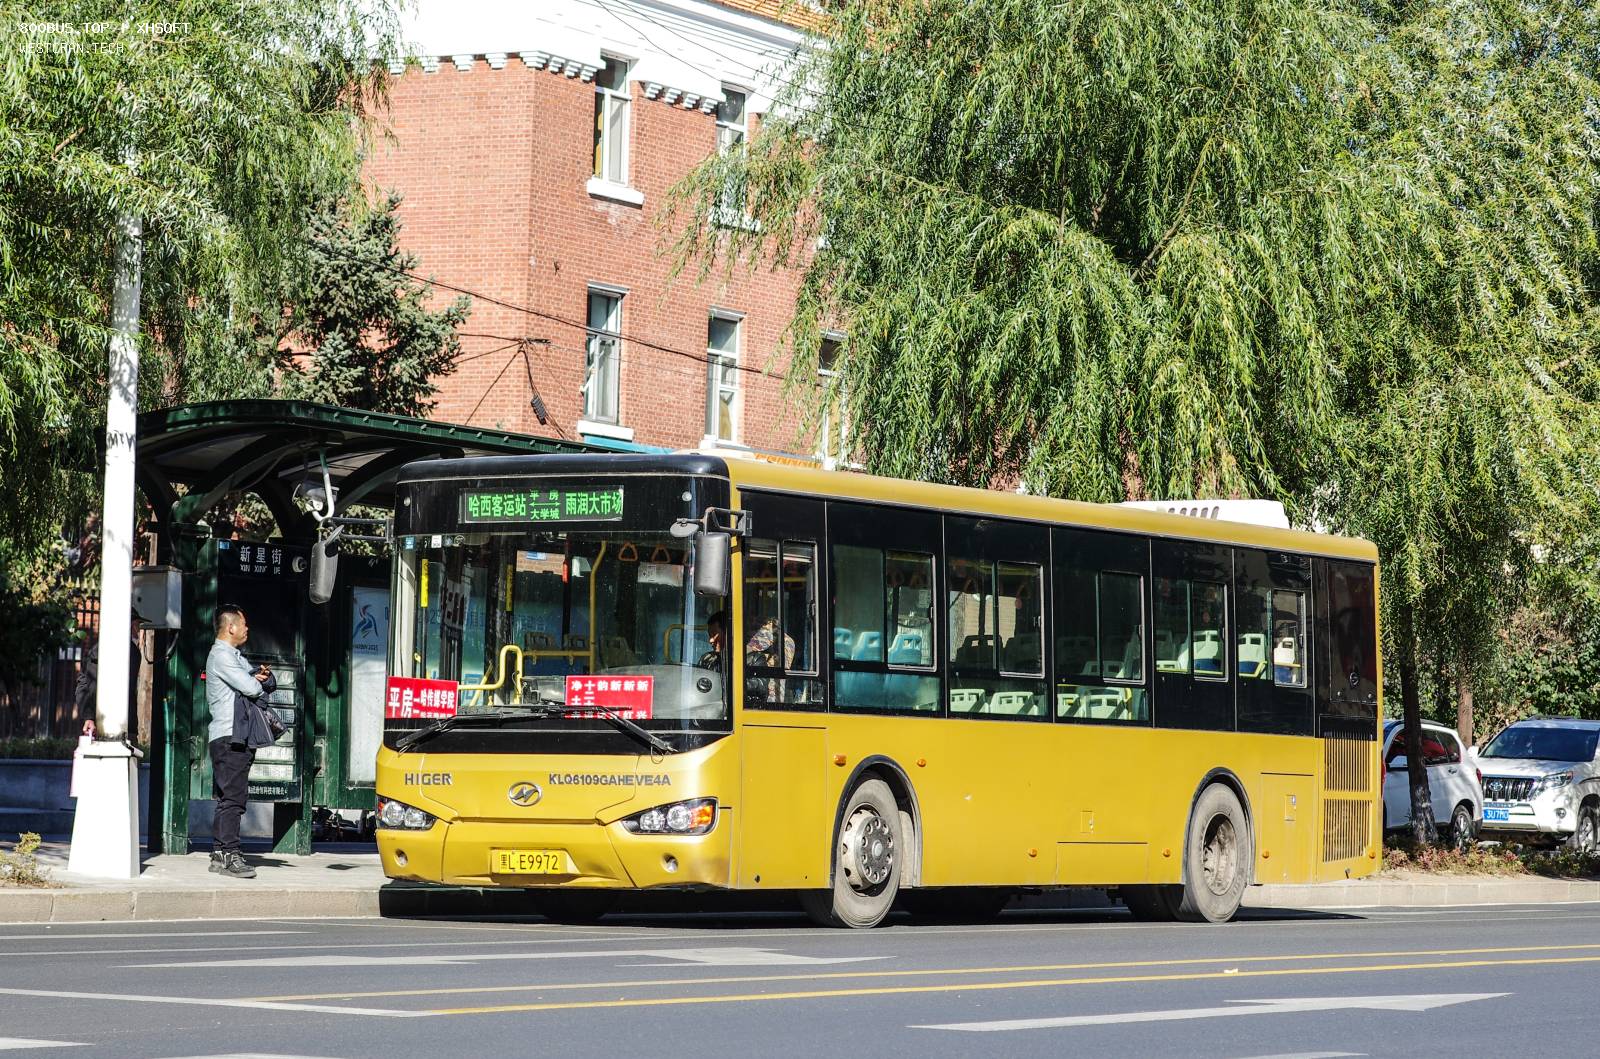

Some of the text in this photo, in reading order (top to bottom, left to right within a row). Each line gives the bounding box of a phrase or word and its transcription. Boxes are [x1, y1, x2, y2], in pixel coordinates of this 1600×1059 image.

[468, 493, 527, 517] 哈西客运站
[565, 491, 623, 515] 雨润大市场
[530, 508, 560, 520] 大学城
[240, 545, 282, 565] 新星街
[388, 686, 413, 718] 平房
[420, 688, 455, 709] 哈传媒学院
[404, 772, 453, 787] HIGER
[548, 772, 672, 787] KLQ6109GAHEVE4A
